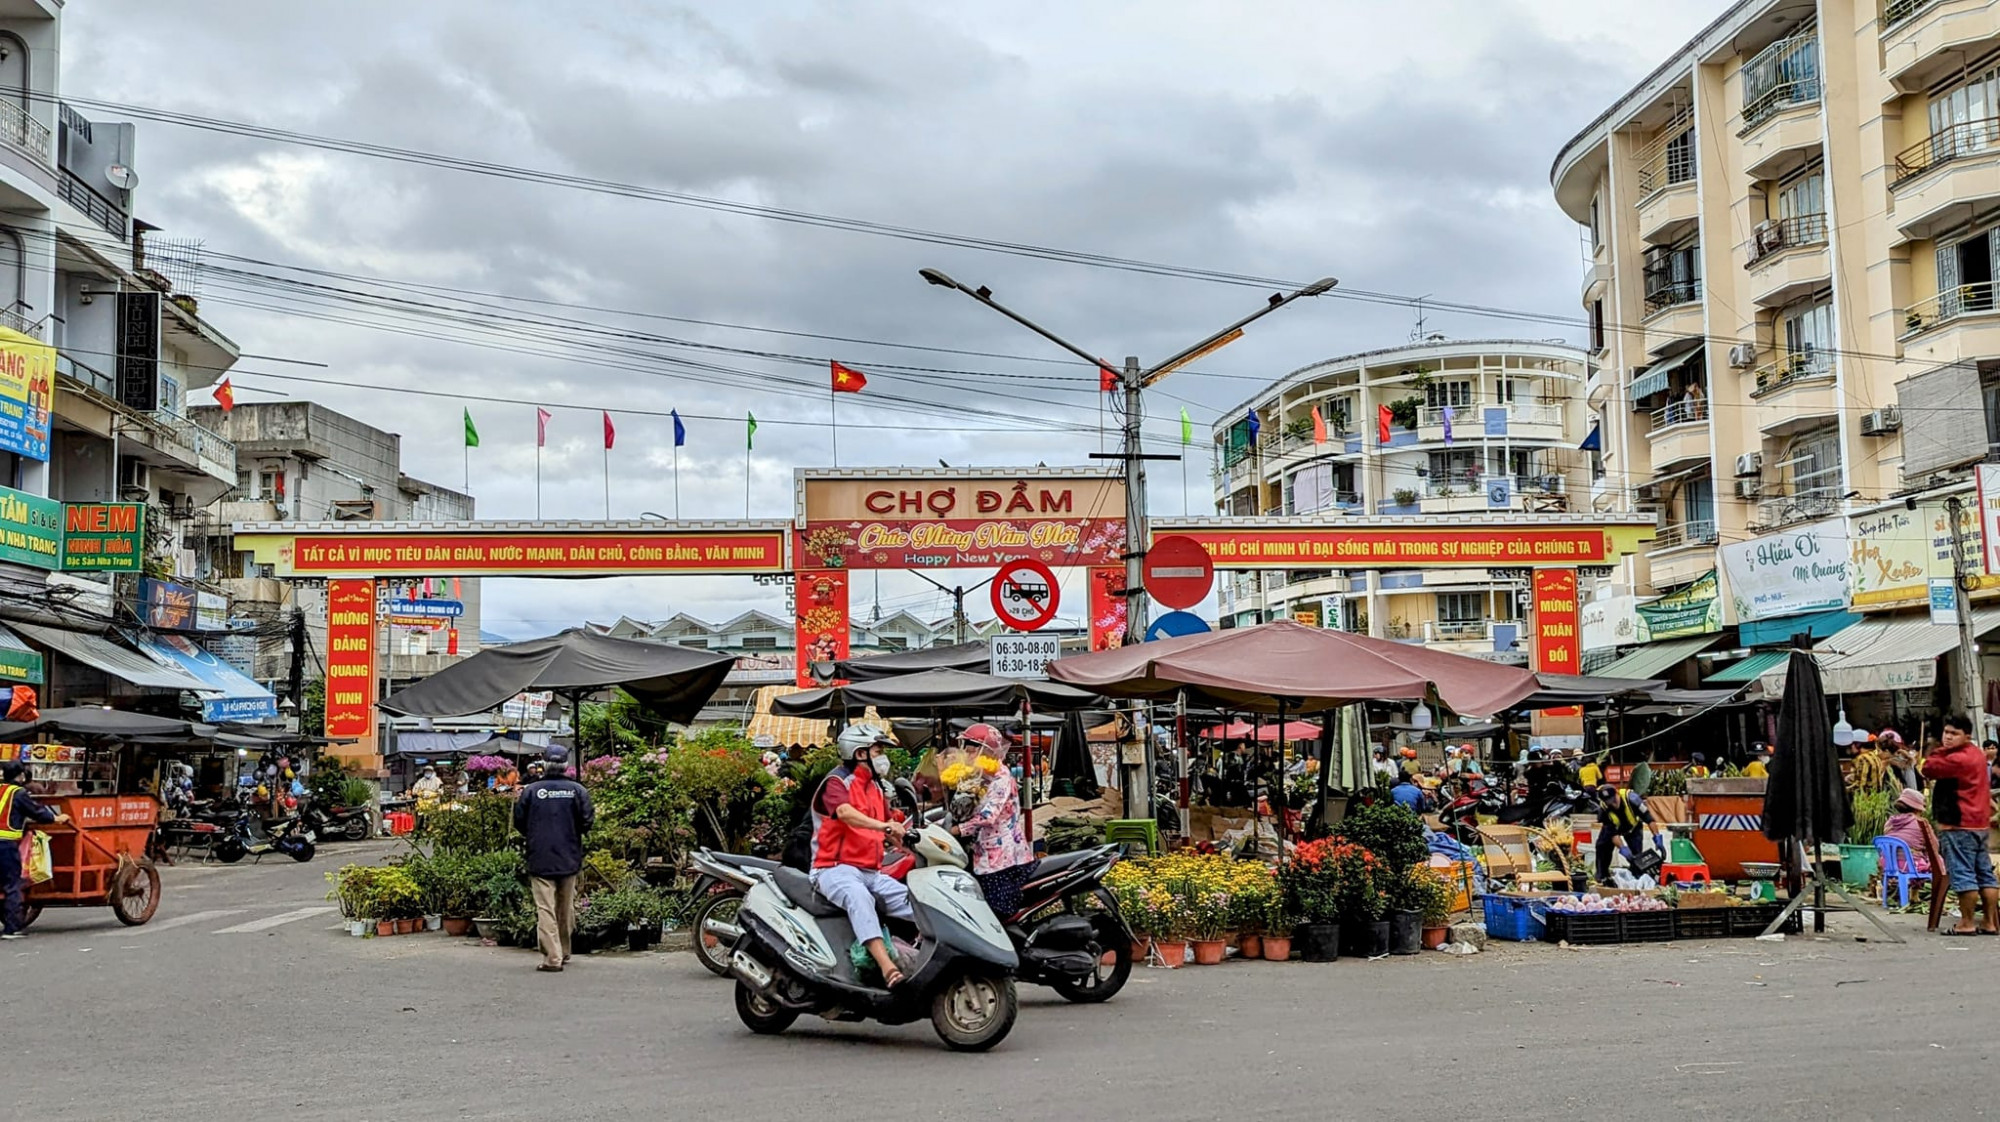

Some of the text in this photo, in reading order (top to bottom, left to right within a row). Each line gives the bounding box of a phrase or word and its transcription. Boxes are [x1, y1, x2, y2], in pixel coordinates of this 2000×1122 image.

[865, 480, 1072, 518] CHỢ ĐẦM
[0, 493, 28, 525] TÂM
[66, 505, 137, 533] NEM
[7, 530, 26, 549] NHA
[28, 535, 56, 557] TRANG
[859, 522, 1080, 553] Chúc Mừng Năm Mới
[303, 543, 764, 563] TẤT CẢ VÌ MỤC TIÊU DÂN GIÀU, NƯỚC MẠNH, DÂN CHỦ, CÔNG BẰNG, VĂN MINH
[1240, 540, 1259, 555] CHÍ
[1263, 542, 1295, 555] MINH
[1298, 540, 1310, 555] VĨ
[1313, 542, 1333, 558] ĐẠI
[1337, 539, 1369, 555] SỐNG
[1373, 540, 1396, 555] MÃI
[1400, 542, 1438, 555] TRONG
[1441, 541, 1458, 557] SỰ
[1461, 539, 1504, 557] NGHIỆP
[1507, 538, 1531, 554] CỦA
[1535, 539, 1574, 554] CHÚNG
[1577, 541, 1591, 554] TA
[67, 556, 80, 566] Đặc
[97, 557, 111, 565] Nha
[113, 557, 132, 567] Trang
[905, 551, 1030, 565] Happy New Year
[1540, 598, 1573, 612] MỪNG
[332, 610, 369, 625] MỪNG
[1543, 623, 1573, 637] XUÂN
[333, 634, 367, 651] ĐẢNG
[996, 641, 1055, 655] 06:30-08:00
[330, 665, 368, 677] QUANG
[997, 658, 1054, 672] 16:30-18:
[335, 692, 362, 704] VINH
